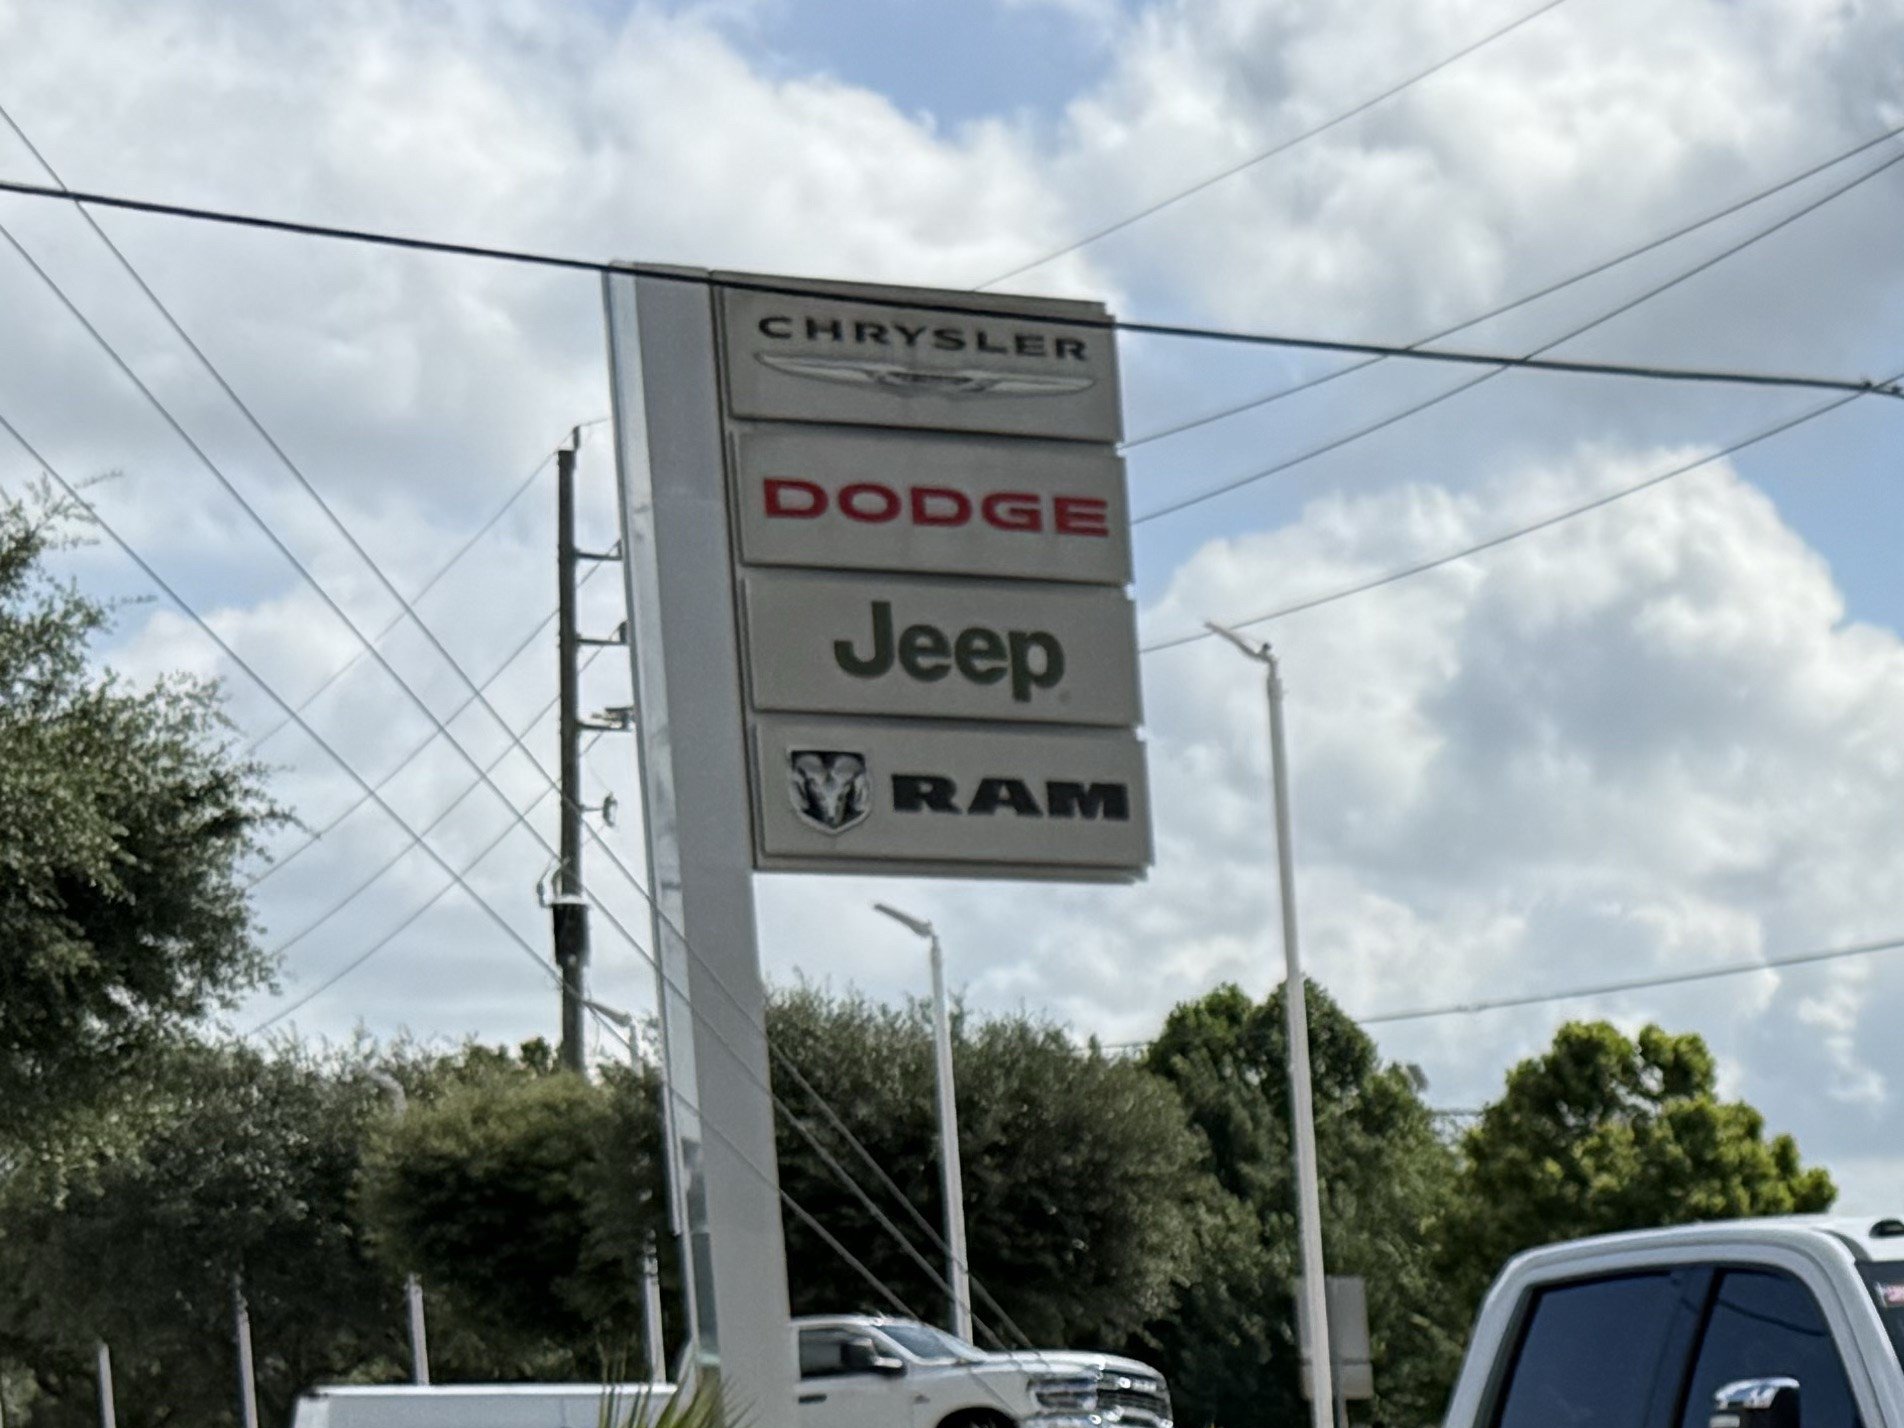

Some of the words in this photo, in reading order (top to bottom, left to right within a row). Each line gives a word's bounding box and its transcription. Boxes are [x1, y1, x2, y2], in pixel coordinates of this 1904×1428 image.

[758, 315, 1089, 362] CHRYSLER
[762, 476, 1110, 538] DODGE
[833, 600, 1066, 702] Jeep
[891, 773, 1131, 821] RAM
